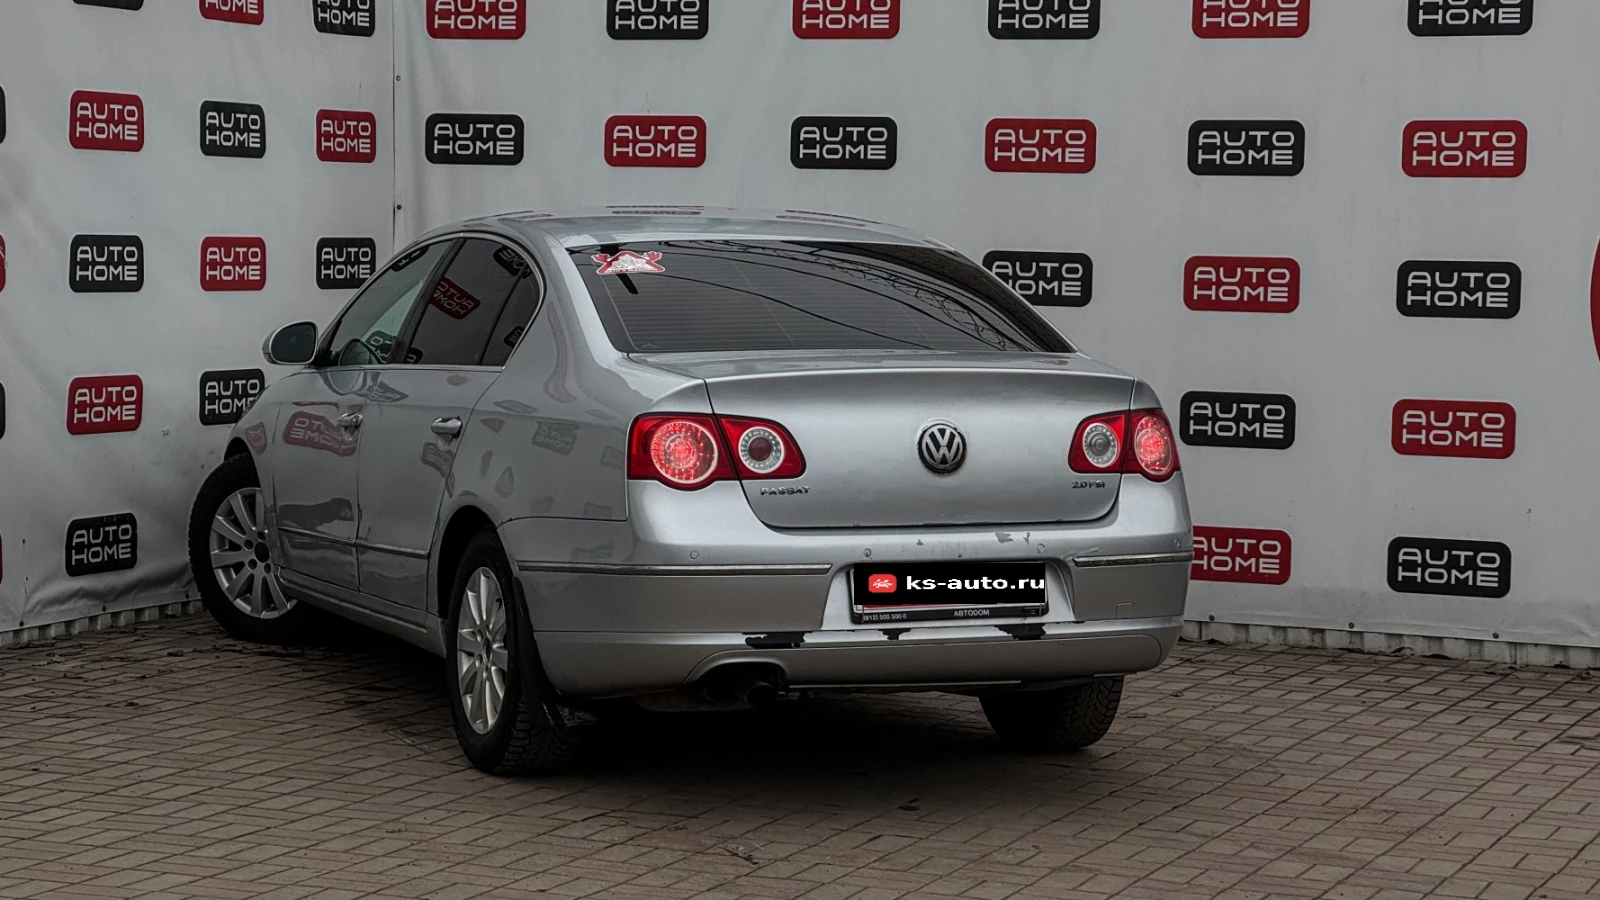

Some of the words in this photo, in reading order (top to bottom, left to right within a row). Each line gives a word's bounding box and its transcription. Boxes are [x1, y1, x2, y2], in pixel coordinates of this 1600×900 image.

[435, 0, 517, 12] AUTO
[616, 0, 700, 12] AUTO
[318, 8, 369, 26] HOME
[435, 15, 516, 29] HOME
[616, 15, 698, 29] HOME
[802, 14, 889, 28] HOME
[998, 14, 1088, 28] HOME
[1203, 11, 1298, 27] HOME
[1419, 8, 1520, 24] HOME
[77, 102, 138, 121] AUTO
[206, 112, 260, 129] AUTO
[321, 120, 371, 135] AUTO
[76, 122, 137, 140] HOME
[206, 130, 260, 147] HOME
[434, 124, 515, 138] AUTO
[614, 126, 697, 140] AUTO
[800, 127, 887, 141] AUTO
[995, 129, 1086, 144] AUTO
[1199, 131, 1294, 146] AUTO
[322, 137, 370, 152] HOME
[1414, 132, 1516, 147] AUTO
[434, 140, 514, 155] HOME
[613, 143, 696, 157] HOME
[800, 144, 886, 159] HOME
[994, 147, 1084, 162] HOME
[1198, 150, 1292, 165] HOME
[1413, 151, 1514, 166] HOME
[77, 246, 138, 262] AUTO
[207, 248, 260, 262] AUTO
[322, 248, 371, 262] AUTO
[76, 266, 137, 280] HOME
[206, 266, 260, 280] HOME
[321, 265, 370, 278] HOME
[992, 261, 1083, 279] AUTO
[1194, 267, 1290, 283] AUTO
[1408, 272, 1510, 288] AUTO
[1194, 285, 1288, 302] HOME
[1407, 290, 1508, 307] HOME
[75, 386, 137, 404] AUTO
[205, 379, 260, 396] AUTO
[74, 405, 136, 423] HOME
[1190, 402, 1285, 420] AUTO
[1403, 410, 1505, 428] AUTO
[1190, 420, 1284, 438] HOME
[1402, 429, 1503, 447] HOME
[760, 485, 810, 496] PASSAT
[72, 524, 132, 546] AUTO
[1193, 536, 1282, 556] AUTO
[72, 543, 131, 565] HOME
[1399, 548, 1500, 568] AUTO
[1398, 566, 1498, 586] HOME
